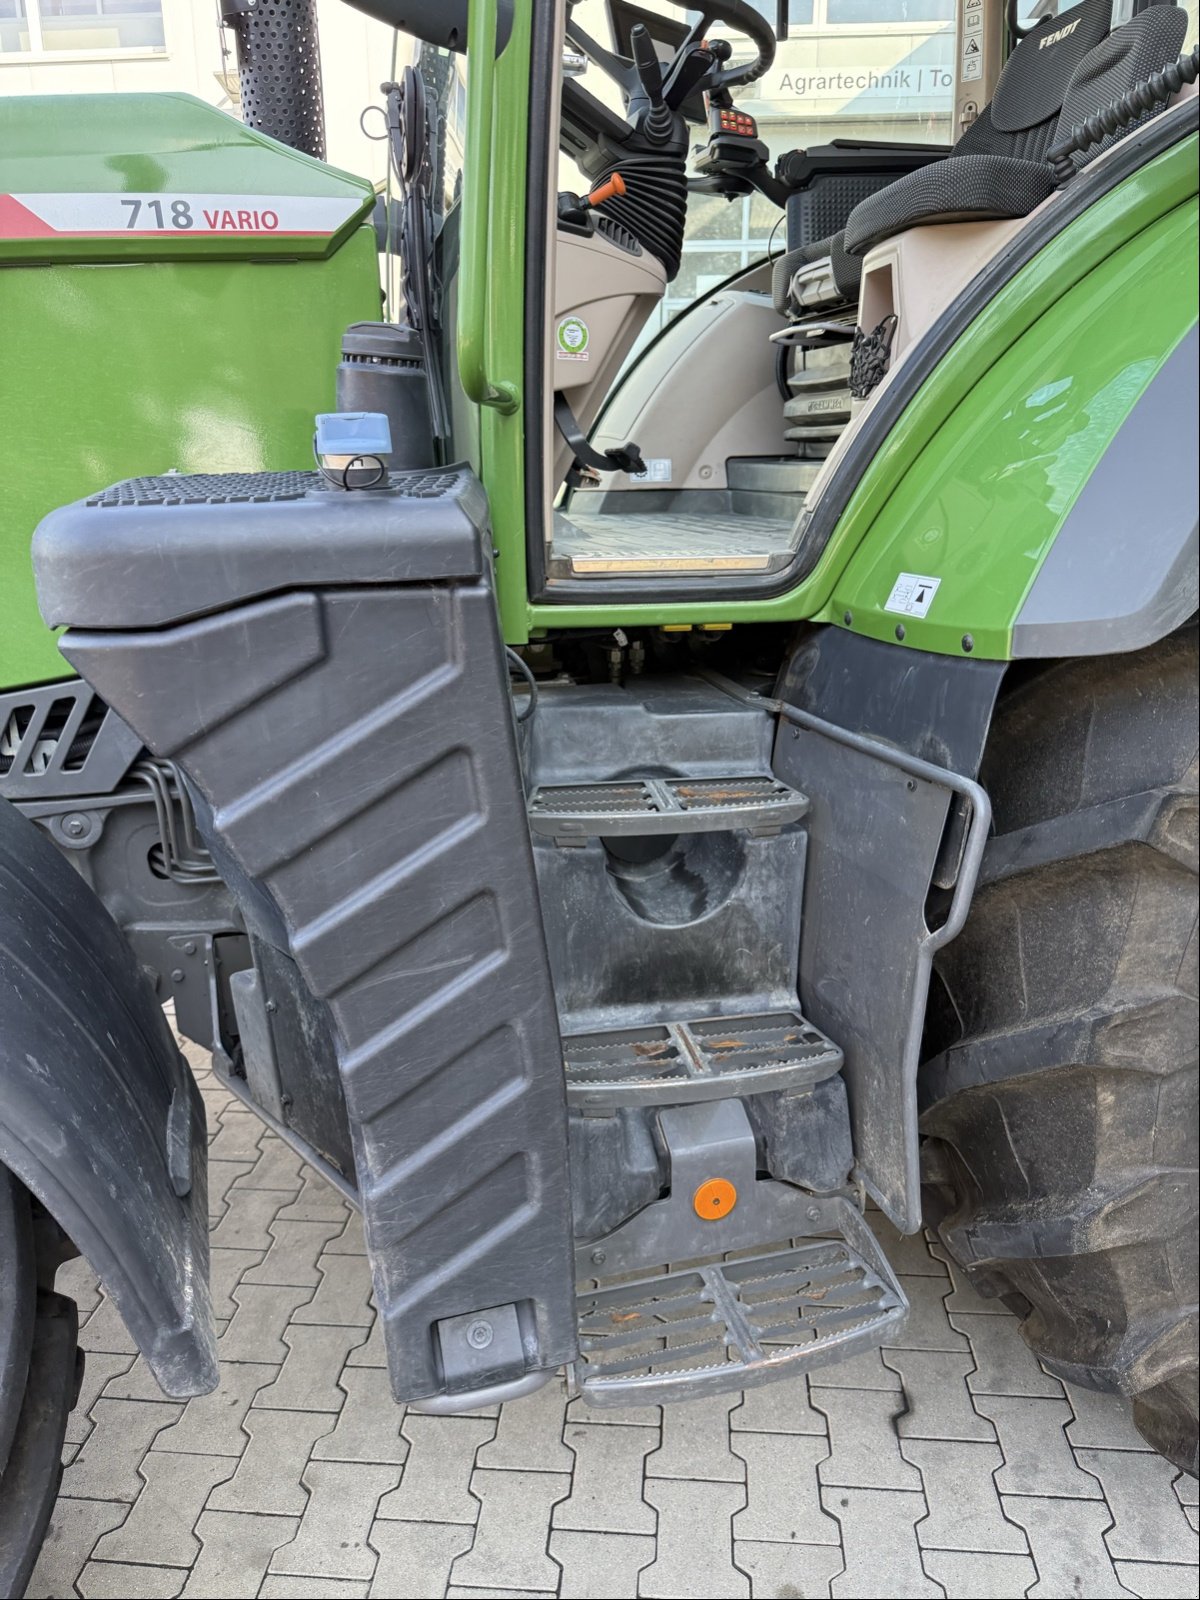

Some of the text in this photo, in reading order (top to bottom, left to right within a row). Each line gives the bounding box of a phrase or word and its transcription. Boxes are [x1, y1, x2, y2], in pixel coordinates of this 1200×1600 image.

[1038, 18, 1081, 50] FENDT
[779, 71, 910, 95] Agrartechnik
[121, 200, 279, 230] 718 VARIO
